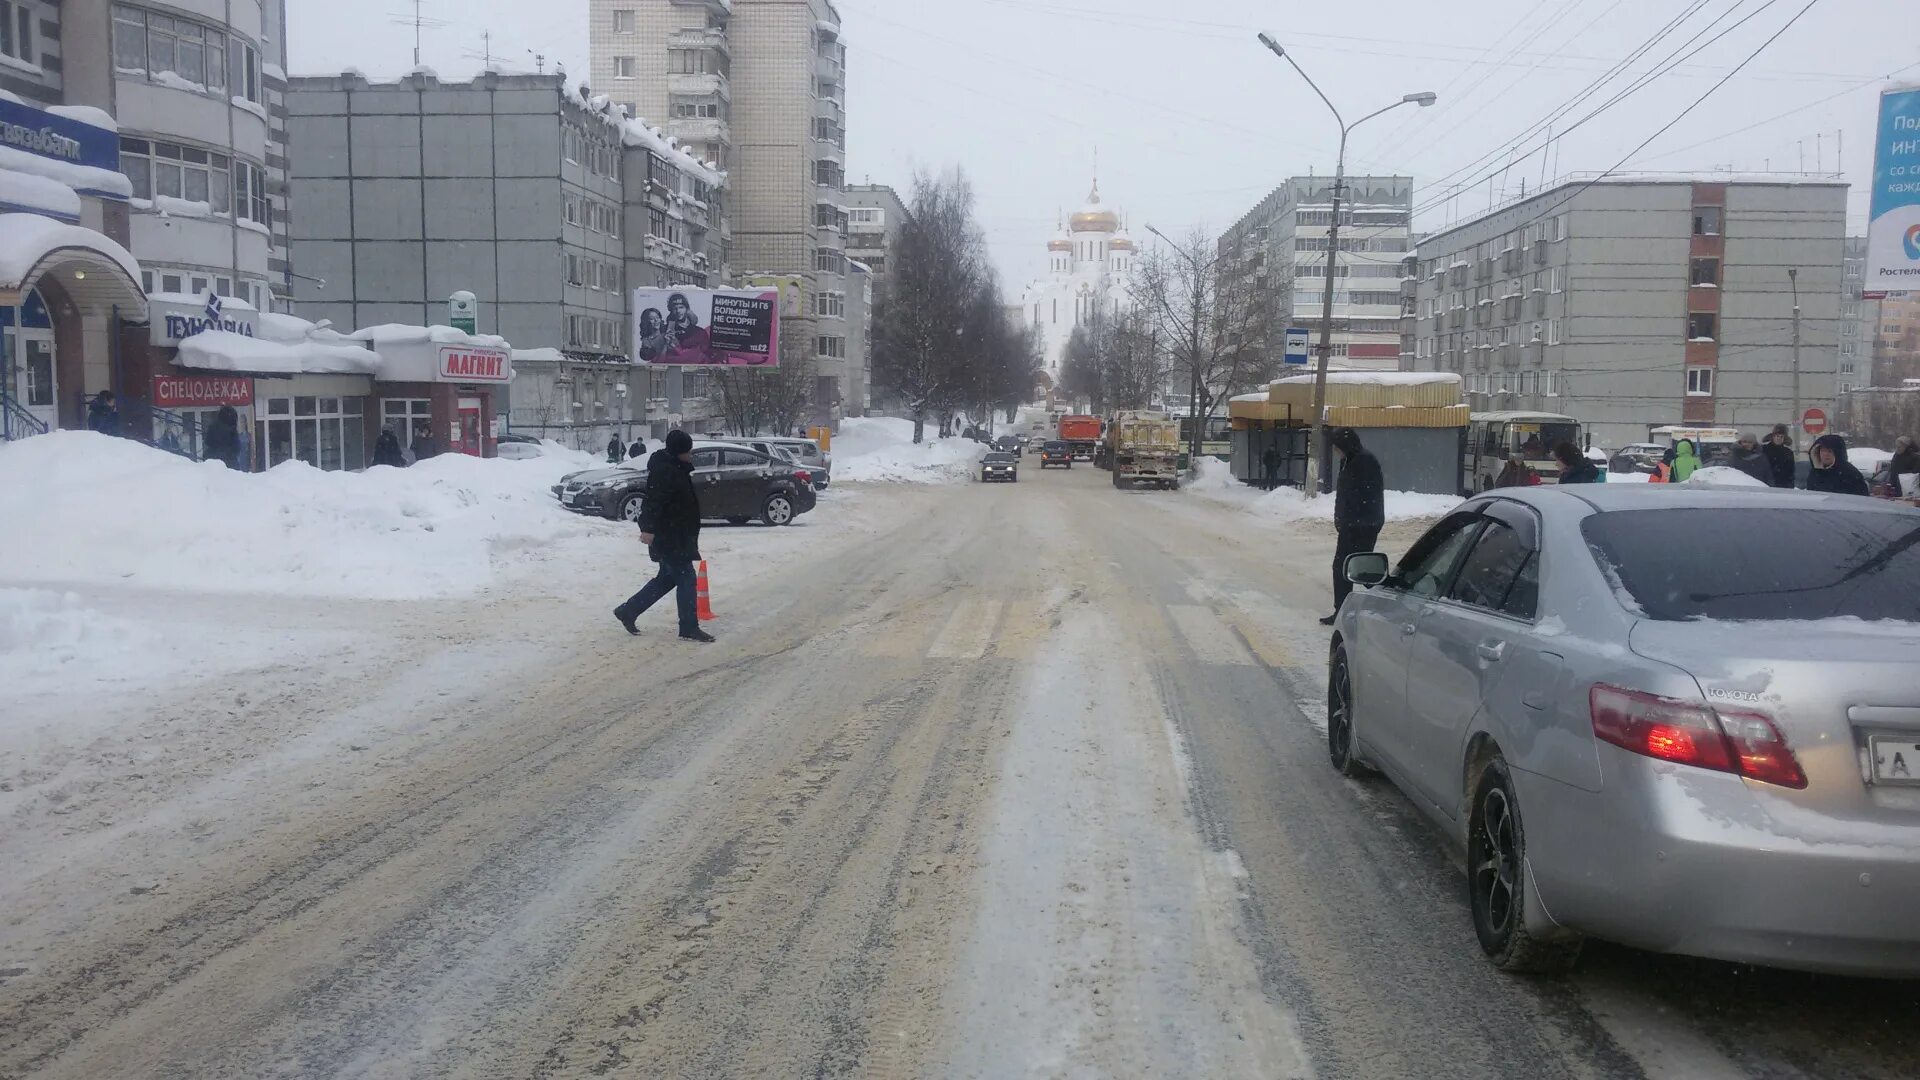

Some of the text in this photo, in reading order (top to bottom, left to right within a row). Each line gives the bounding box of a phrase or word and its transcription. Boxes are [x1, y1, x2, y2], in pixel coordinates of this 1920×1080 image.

[714, 298, 750, 308] МИНУТЫ
[751, 301, 758, 309] И
[714, 306, 749, 317] БОЛЬШЕ
[713, 315, 758, 326] НЕ СГОРЯТ
[447, 353, 503, 376] МАГНИТ
[159, 380, 249, 401] СПЕЦОДЕЖДА
[1708, 688, 1760, 702] TOYOTA
